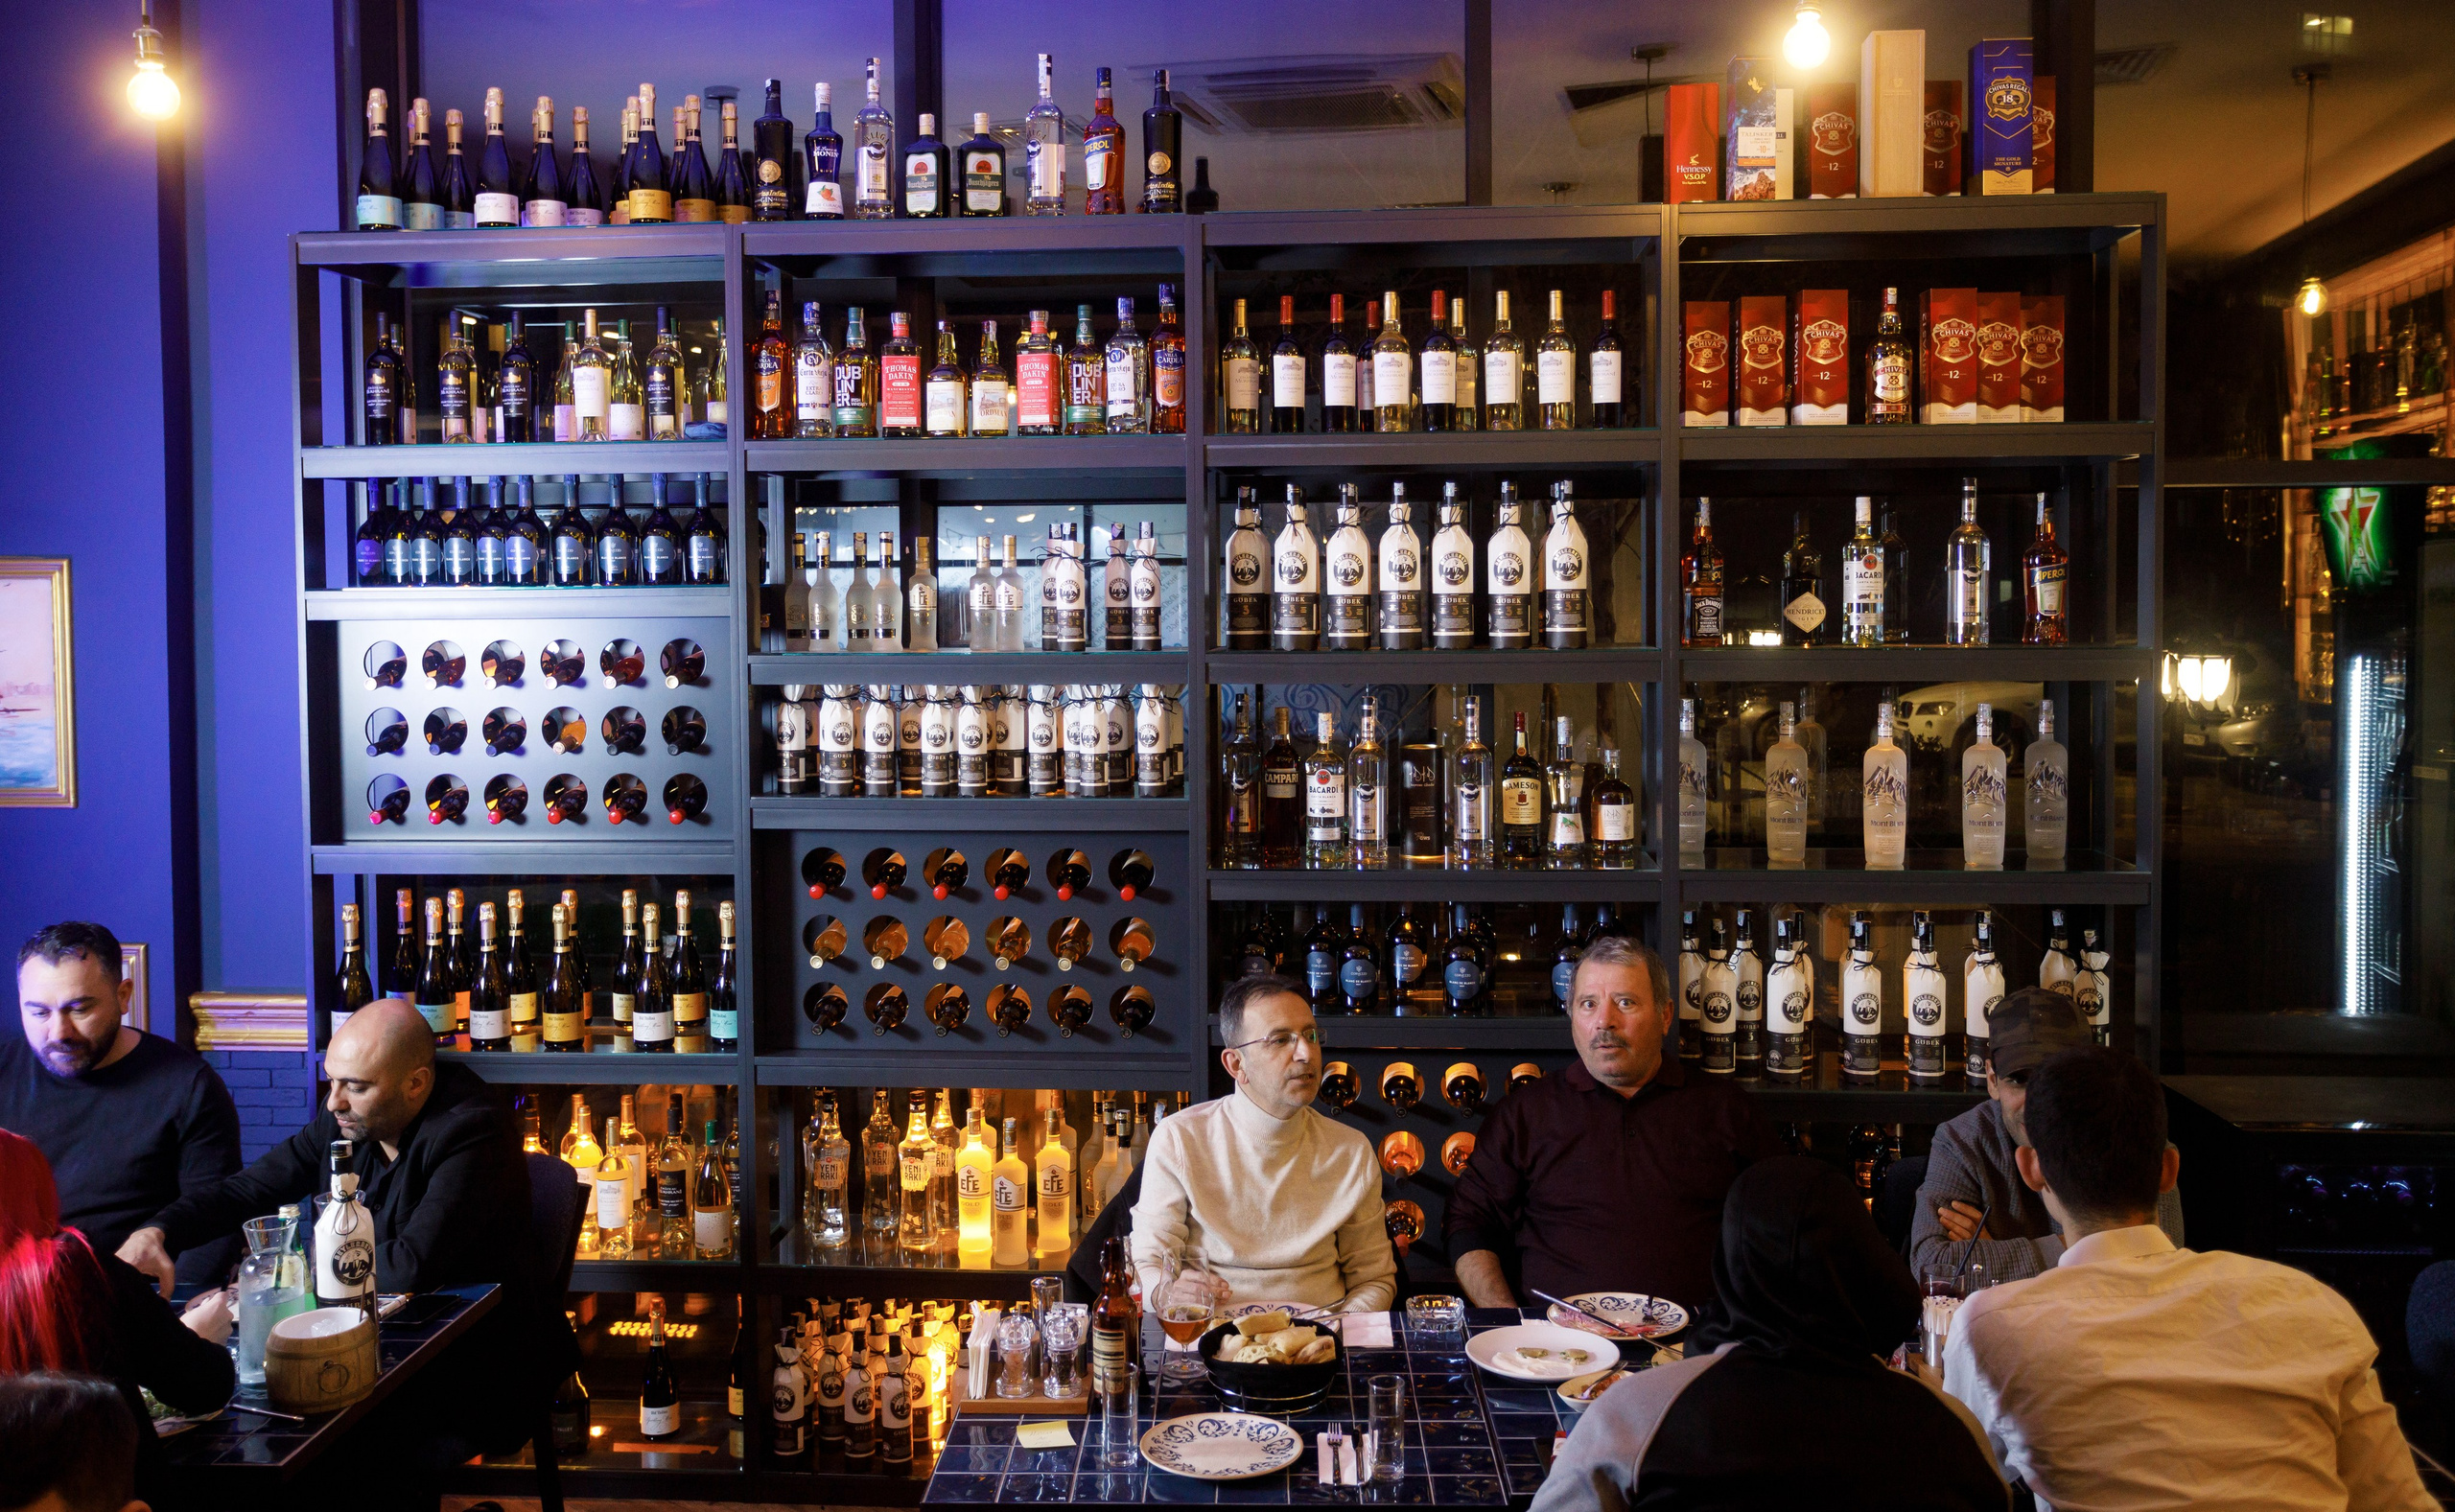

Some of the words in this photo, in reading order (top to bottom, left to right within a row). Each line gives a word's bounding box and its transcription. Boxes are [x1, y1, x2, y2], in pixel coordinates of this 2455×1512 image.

[1988, 83, 2009, 94] CHIVAS
[2009, 83, 2029, 93] REGAL
[1819, 122, 1848, 130] CHIVAS
[1676, 165, 1712, 174] Hennessy
[1828, 162, 1839, 171] 12
[1811, 330, 1839, 338] CHIVAS
[1938, 328, 1970, 337] CHIVAS
[1983, 332, 2014, 341] CHIVAS
[1693, 339, 1720, 348] CHIVAS
[1748, 336, 1777, 344] CHIVAS
[2027, 335, 2057, 344] CHIVAS
[755, 361, 779, 370] CARDEA
[884, 364, 917, 374] THOMAS
[1019, 362, 1049, 372] THOMAS
[1072, 363, 1102, 378] DUB
[1878, 366, 1907, 375] CHIVAS
[835, 366, 862, 381] DUB
[888, 372, 913, 381] DAKIN
[1022, 370, 1046, 380] DAKIN
[1819, 371, 1831, 380] 12
[1949, 370, 1960, 379] 12
[1993, 373, 2003, 382] 12
[1073, 377, 1096, 391] LIN
[1701, 380, 1712, 388] 12
[1757, 376, 1767, 384] 12
[2037, 375, 2047, 384] 12
[836, 380, 854, 393] LIN
[836, 393, 851, 407] ER
[1073, 391, 1092, 405] ER
[1289, 604, 1297, 615] 3
[1400, 602, 1408, 613] 3
[1565, 601, 1572, 612] 3
[1695, 599, 1704, 610] JACK
[1242, 605, 1250, 616] 3
[1344, 606, 1352, 616] 3
[1451, 605, 1459, 616] 3
[1506, 606, 1513, 616] 3
[1265, 773, 1299, 783] CAMPARI
[1505, 780, 1539, 792] JAMESON
[1747, 1033, 1753, 1041] 3
[904, 1173, 922, 1181] RAKI
[960, 1175, 980, 1194] EFE
[1043, 1175, 1064, 1194] EFE
